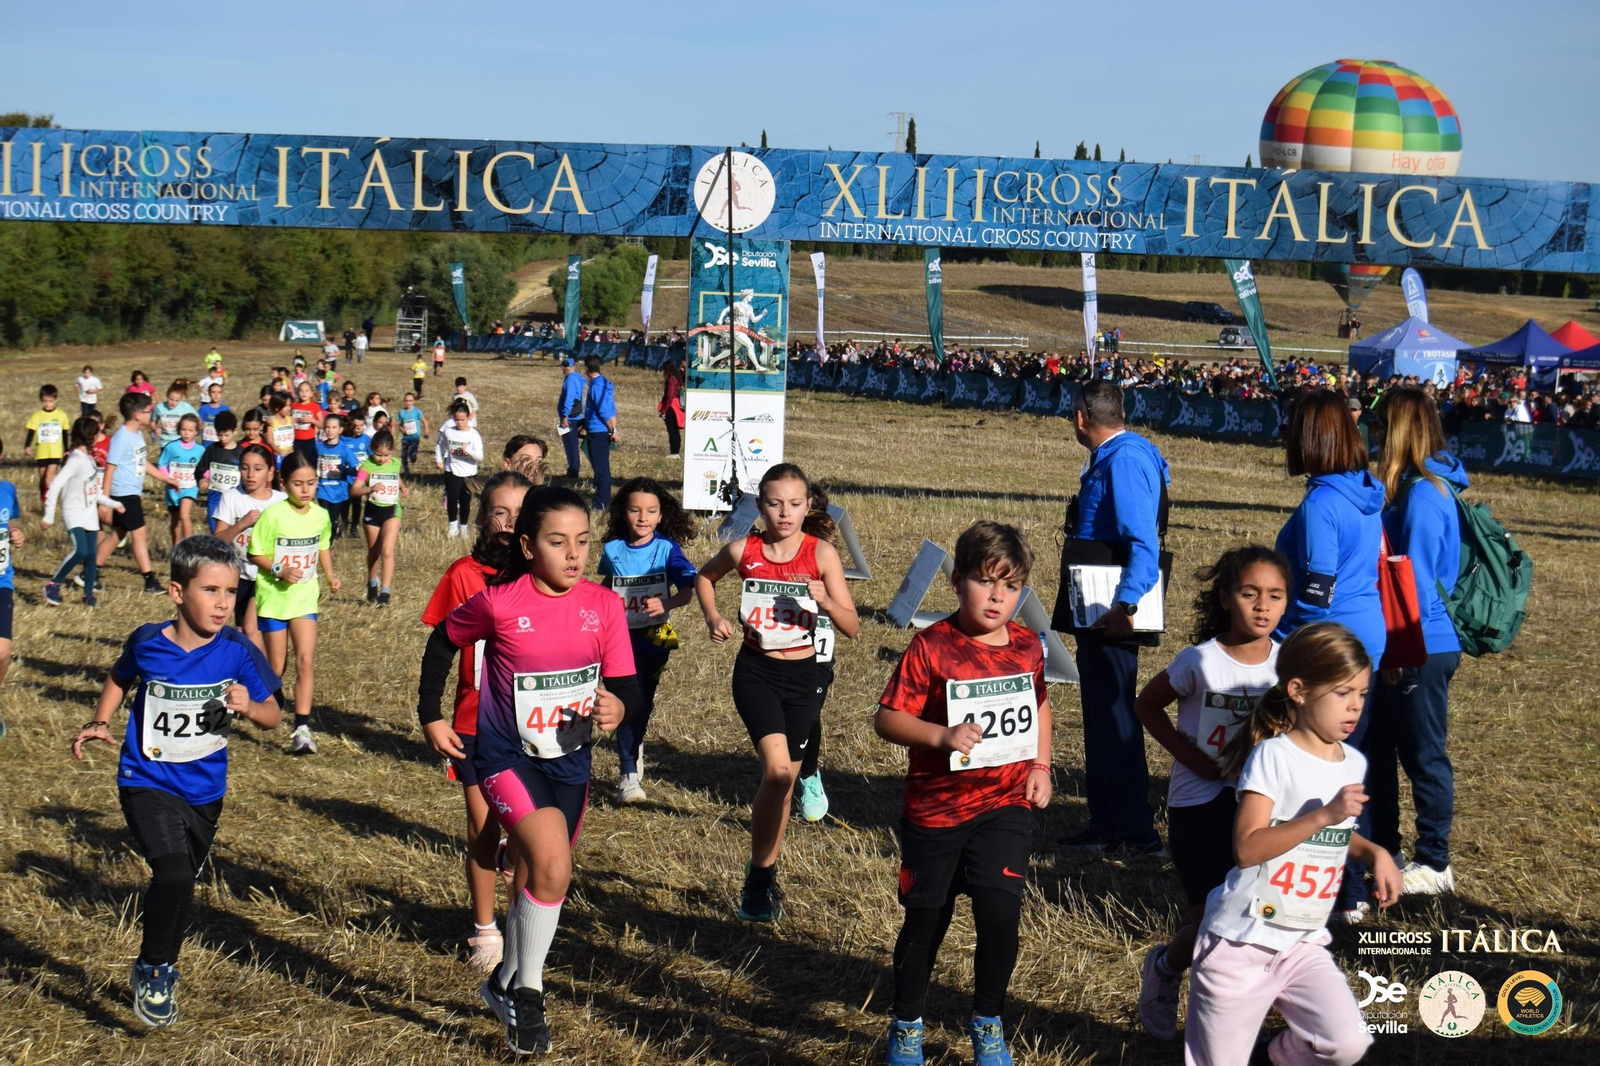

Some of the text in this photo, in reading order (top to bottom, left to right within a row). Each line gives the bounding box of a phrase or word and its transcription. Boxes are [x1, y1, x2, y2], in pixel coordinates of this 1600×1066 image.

[0, 142, 76, 197] III
[80, 144, 214, 179] CROSS
[1392, 153, 1420, 173] Hay
[274, 136, 593, 215] ITÁLICA
[80, 181, 260, 201] INTERNACIONAL
[821, 162, 988, 223] XLIII
[993, 170, 1122, 207] CROSS
[69, 202, 131, 219] CROSS
[134, 203, 229, 222] COUNTRY
[993, 206, 1168, 230] INTERNACIONAL
[1181, 168, 1492, 250] ITÁLICA
[820, 222, 1136, 250] INTERNATIONAL CROSS COUNTRY
[741, 258, 776, 268] Sevilla
[742, 250, 777, 258] Diputación
[1460, 444, 1486, 459] Sevilla
[212, 473, 238, 485] 4289
[280, 552, 317, 569] 4514
[764, 583, 800, 595] ITÁLICA
[747, 606, 813, 632] 4530
[543, 674, 583, 687] ITÁLICA
[975, 681, 1017, 695] ITÁLICA
[170, 688, 215, 699] ITÁLICA
[153, 706, 228, 738] 4252
[526, 696, 593, 734] 4476
